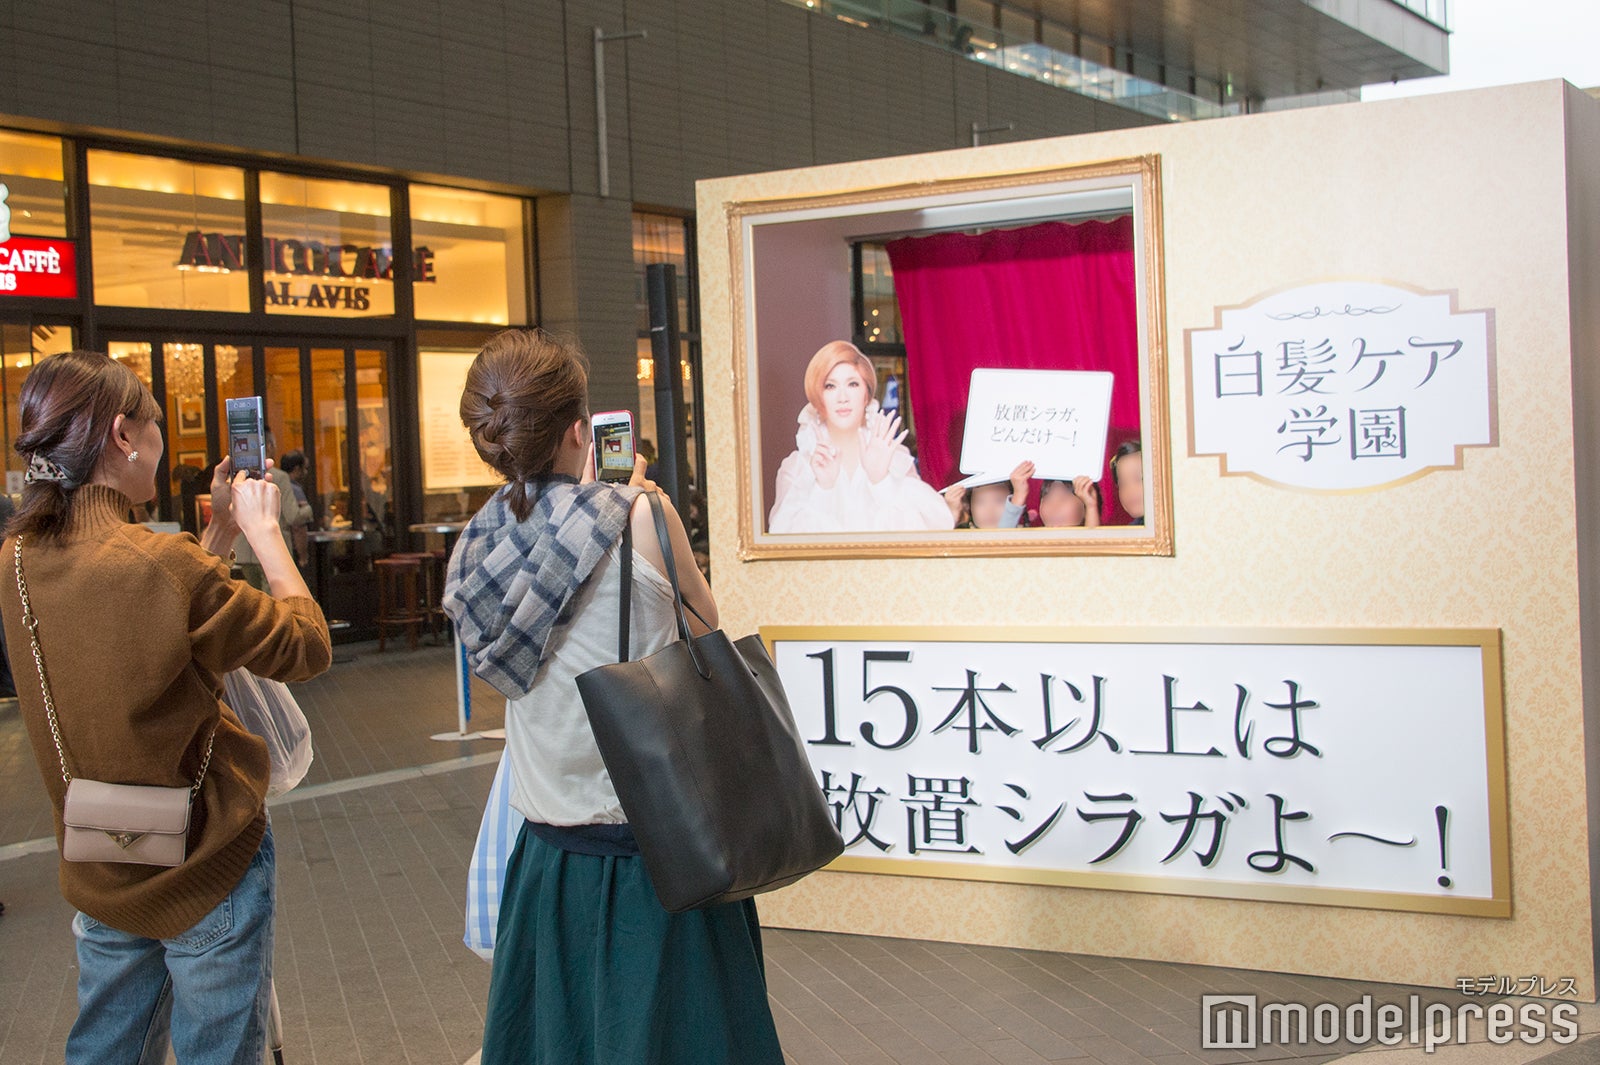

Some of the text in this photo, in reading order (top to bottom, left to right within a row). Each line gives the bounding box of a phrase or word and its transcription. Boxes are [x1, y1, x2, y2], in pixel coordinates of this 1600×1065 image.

[306, 284, 370, 311] AVIS
[1214, 335, 1464, 399] 白髪ケア
[993, 403, 1079, 423] 放置シラガ、
[1276, 404, 1407, 462] 学園
[805, 647, 1323, 759] 15本以上は
